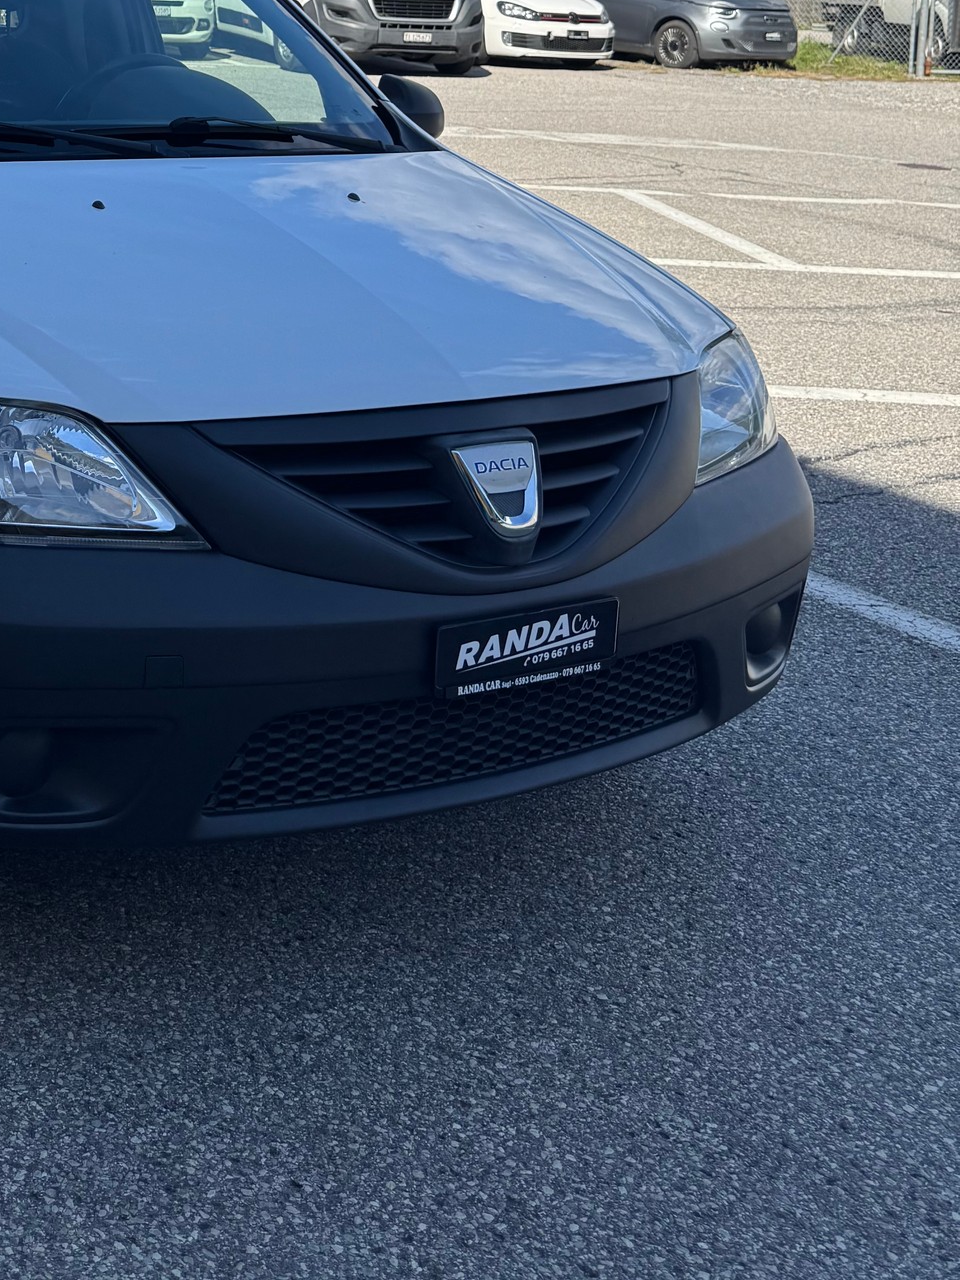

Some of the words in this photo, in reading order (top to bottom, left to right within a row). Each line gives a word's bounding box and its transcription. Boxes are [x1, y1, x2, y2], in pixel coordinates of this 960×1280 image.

[474, 457, 529, 474] DACIA
[455, 613, 569, 670] RANDA
[572, 613, 599, 634] Car
[532, 651, 550, 664] 079
[551, 646, 568, 659] 667
[570, 642, 581, 653] 16
[582, 639, 594, 650] 65
[457, 682, 485, 696] RANDA
[485, 679, 501, 691] CAR
[514, 675, 529, 686] 6593
[562, 667, 573, 677] 079
[574, 665, 585, 675] 667
[585, 663, 593, 673] 16
[593, 662, 601, 671] 65
